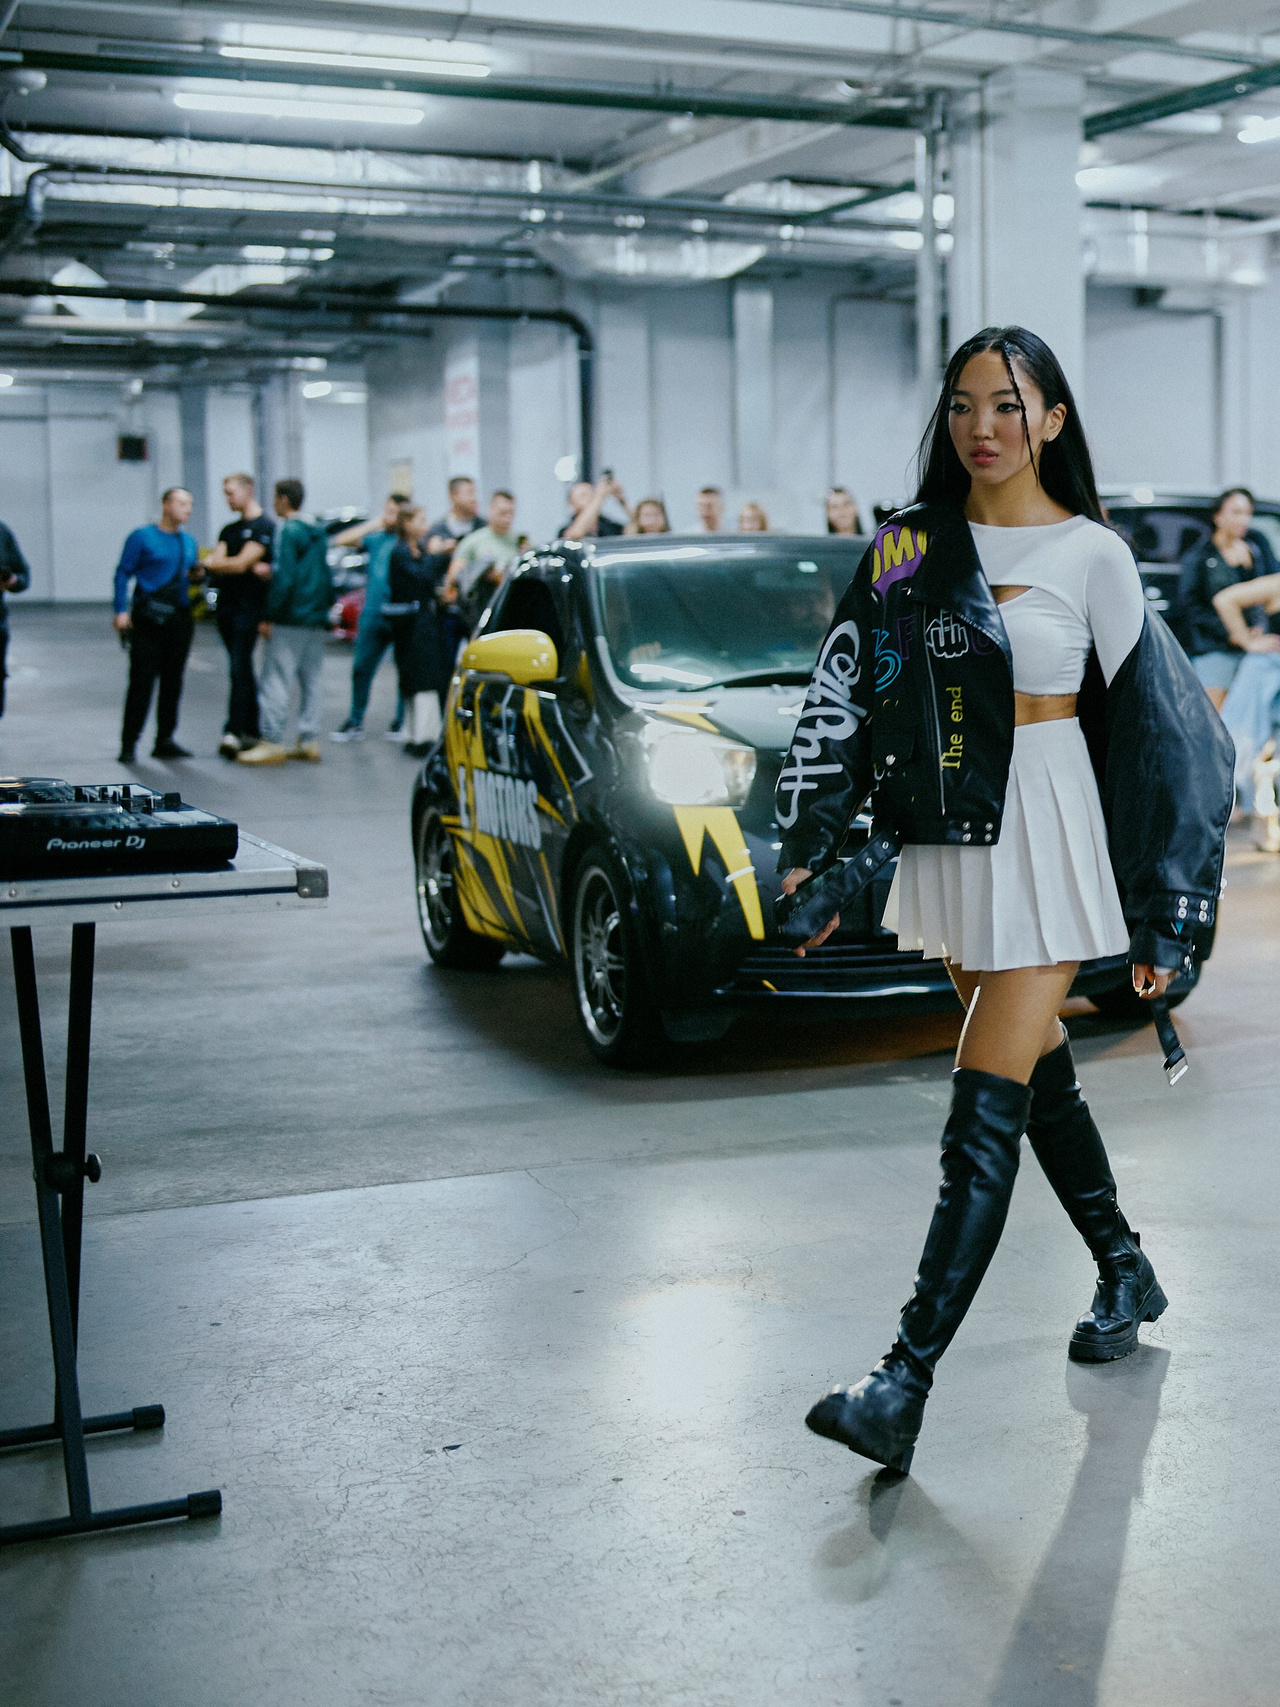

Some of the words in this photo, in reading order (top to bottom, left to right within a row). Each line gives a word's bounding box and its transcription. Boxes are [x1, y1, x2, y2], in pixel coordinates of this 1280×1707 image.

[946, 686, 962, 722] end
[941, 733, 963, 771] The
[473, 768, 541, 850] MOTORS
[46, 837, 121, 850] Pioneer
